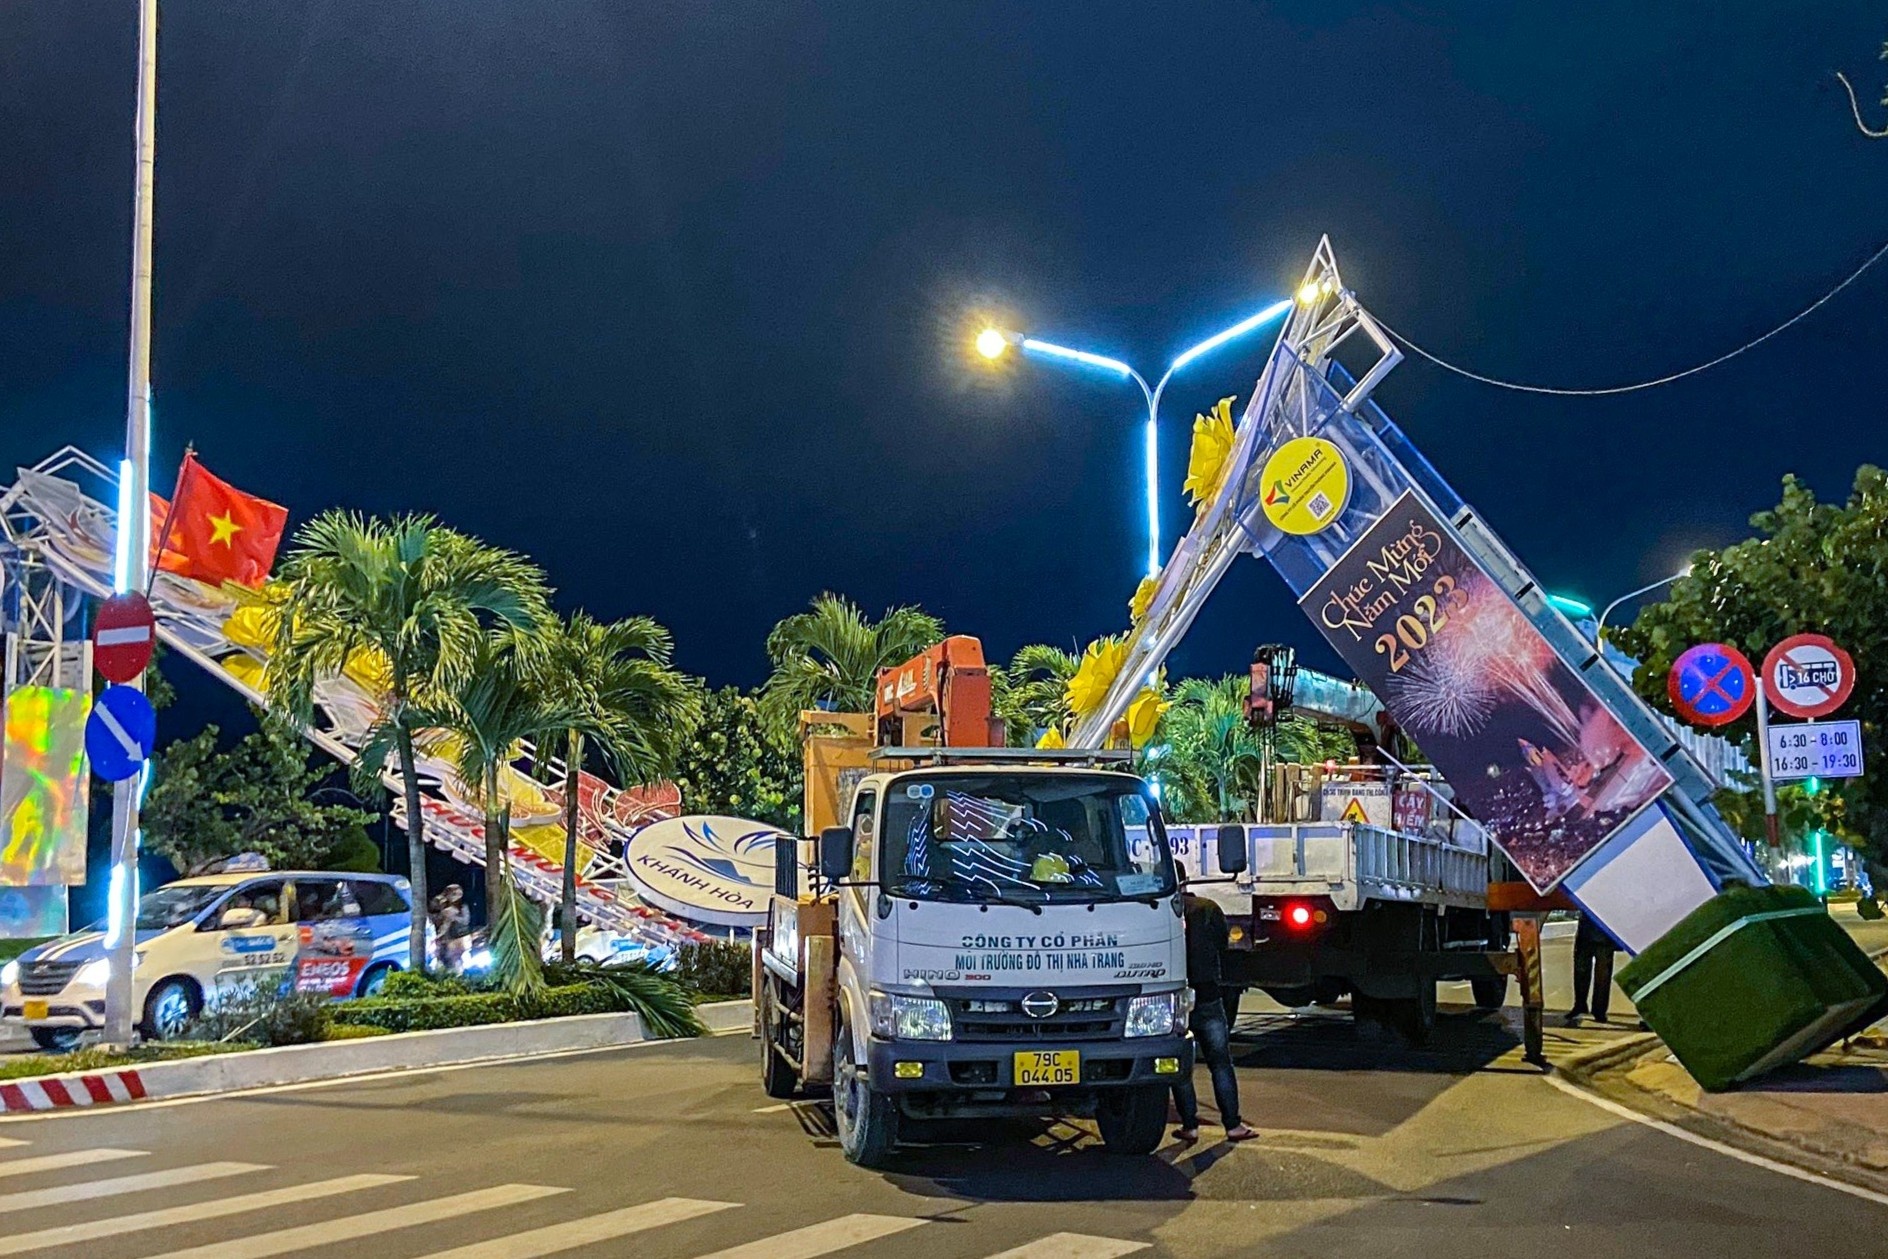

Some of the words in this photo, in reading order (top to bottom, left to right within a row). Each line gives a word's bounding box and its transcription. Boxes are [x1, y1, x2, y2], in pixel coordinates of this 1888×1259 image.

[1284, 448, 1323, 488] VINAMA
[1321, 577, 1374, 629] Chúc
[1366, 519, 1442, 584] Mừng
[1342, 590, 1399, 642] Năm
[1388, 543, 1435, 596] Mới
[1374, 575, 1469, 673] 2023
[1780, 734, 1807, 748] 6:30
[1821, 731, 1848, 746] 8:00
[1775, 756, 1808, 771] 16:30
[1822, 754, 1856, 769] 19:30
[636, 854, 710, 890] KHÁNH
[709, 886, 755, 910] HÒA
[962, 933, 1012, 948] CÔNG
[1015, 936, 1036, 949] TY
[1041, 930, 1065, 948] CỔ
[981, 949, 1023, 971] TRƯỜNG
[1026, 949, 1042, 970] ĐÔ
[1046, 952, 1063, 973] THỊ
[1067, 952, 1088, 970] NHA
[1091, 951, 1125, 969] TRANG
[903, 969, 961, 981] HINO
[964, 973, 992, 981] 300
[1113, 968, 1167, 978] DUTRO
[1033, 1052, 1061, 1067] 79C
[1021, 1068, 1073, 1083] 044.05
